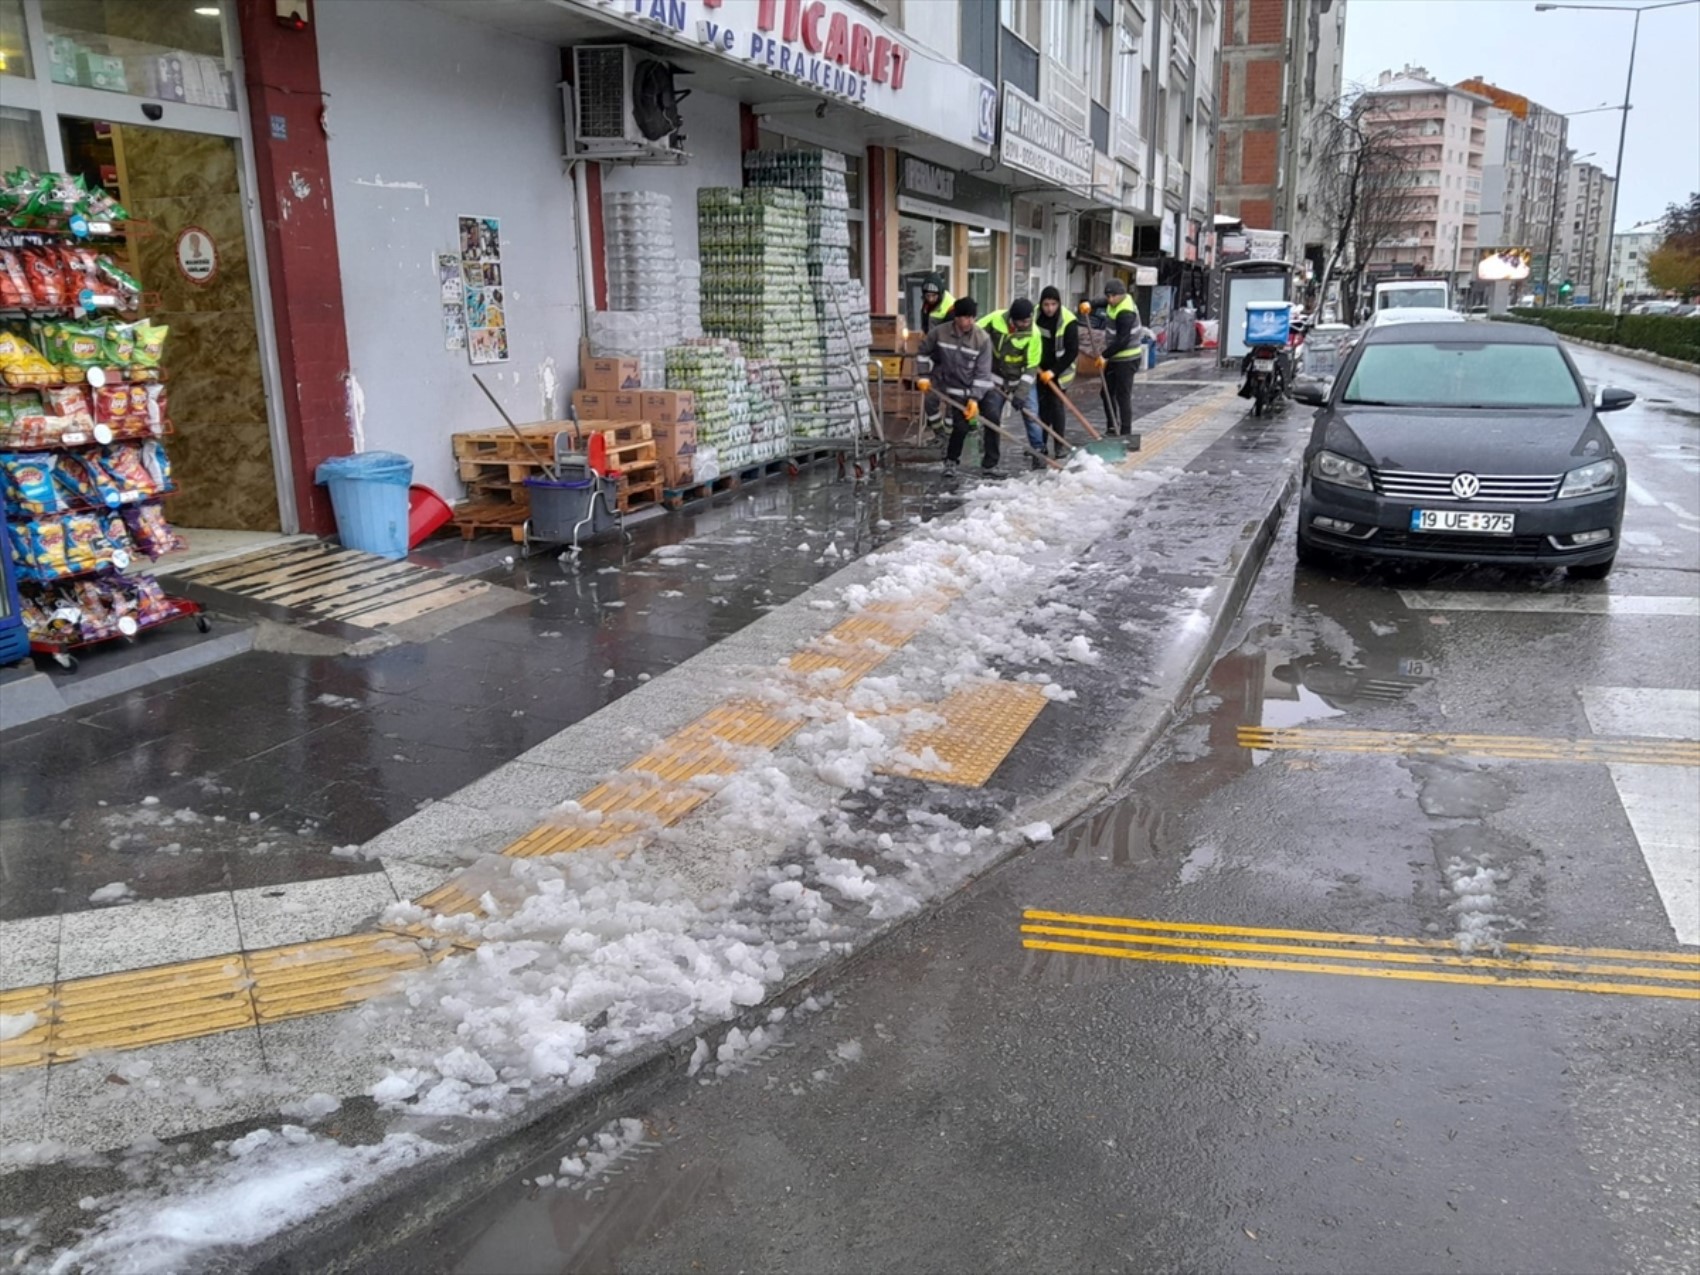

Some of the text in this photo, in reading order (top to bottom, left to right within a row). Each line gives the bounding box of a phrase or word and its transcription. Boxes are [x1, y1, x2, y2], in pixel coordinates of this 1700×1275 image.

[706, 20, 735, 50] ve
[750, 32, 868, 100] PERAKENDE
[1422, 511, 1512, 531] 19 UE 375
